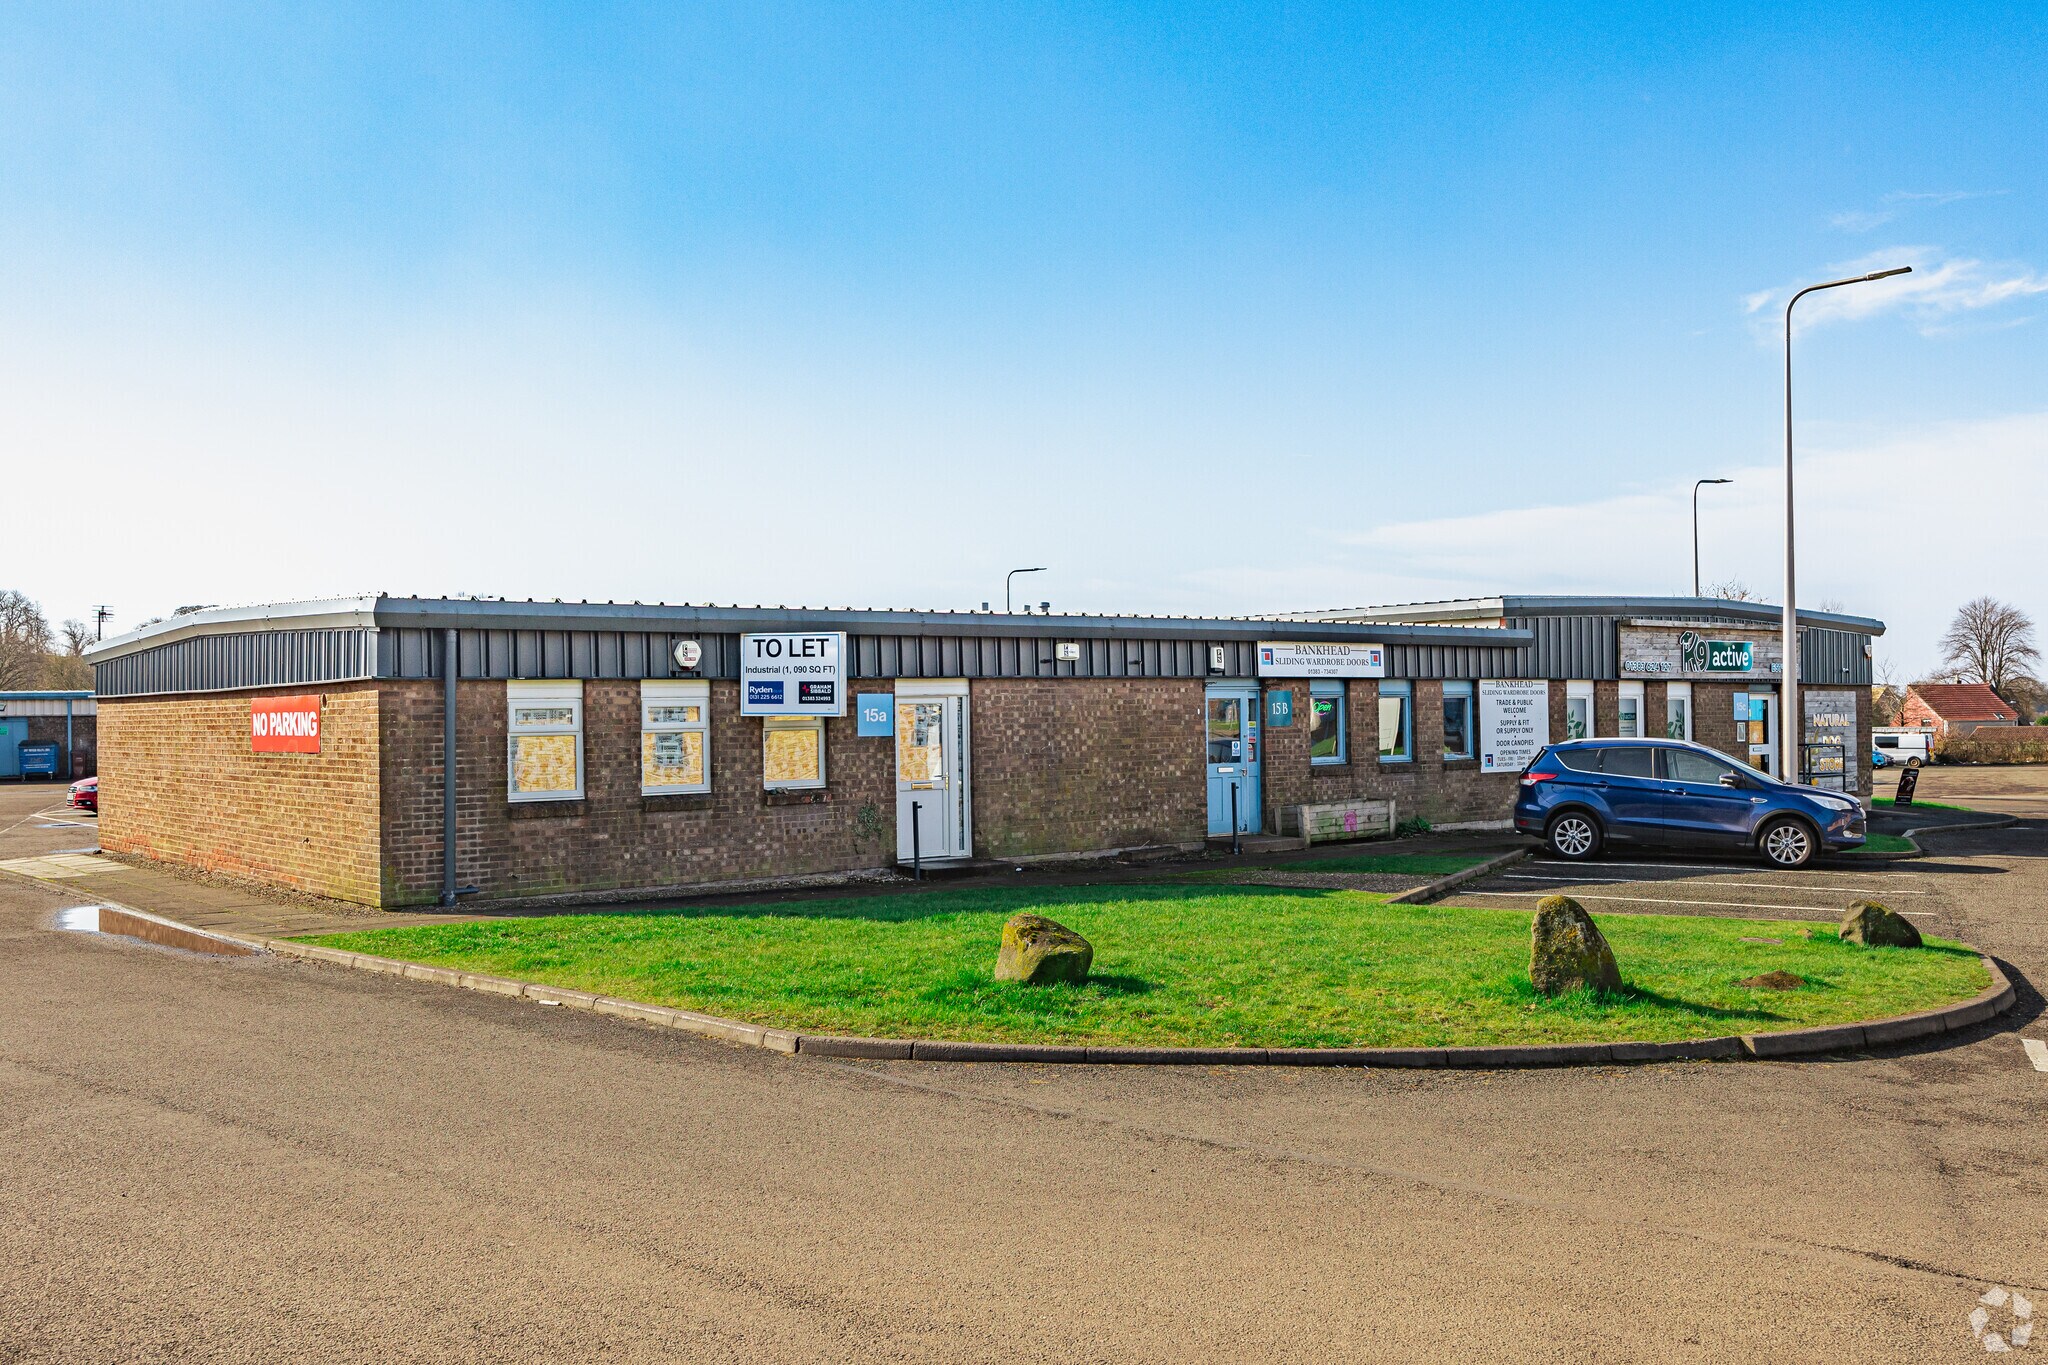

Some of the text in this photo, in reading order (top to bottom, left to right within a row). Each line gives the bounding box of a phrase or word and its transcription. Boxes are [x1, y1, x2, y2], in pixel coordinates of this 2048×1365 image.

[753, 638, 829, 658] TO LET
[1295, 645, 1351, 656] BANKHEAD
[1275, 657, 1370, 666] SLIDING WARDROBE DOORS
[1712, 644, 1749, 667] active
[745, 666, 780, 674] Industrial
[793, 666, 807, 674] 090
[809, 666, 821, 674] SQ
[823, 666, 836, 675] FT)
[1495, 680, 1534, 688] BANKHEAD
[1272, 702, 1288, 715] 15 B
[1312, 701, 1332, 714] Open
[863, 708, 887, 722] 15a
[1813, 713, 1850, 727] NATURAL
[252, 711, 318, 737] NO PARKING
[1822, 735, 1841, 749] DOG
